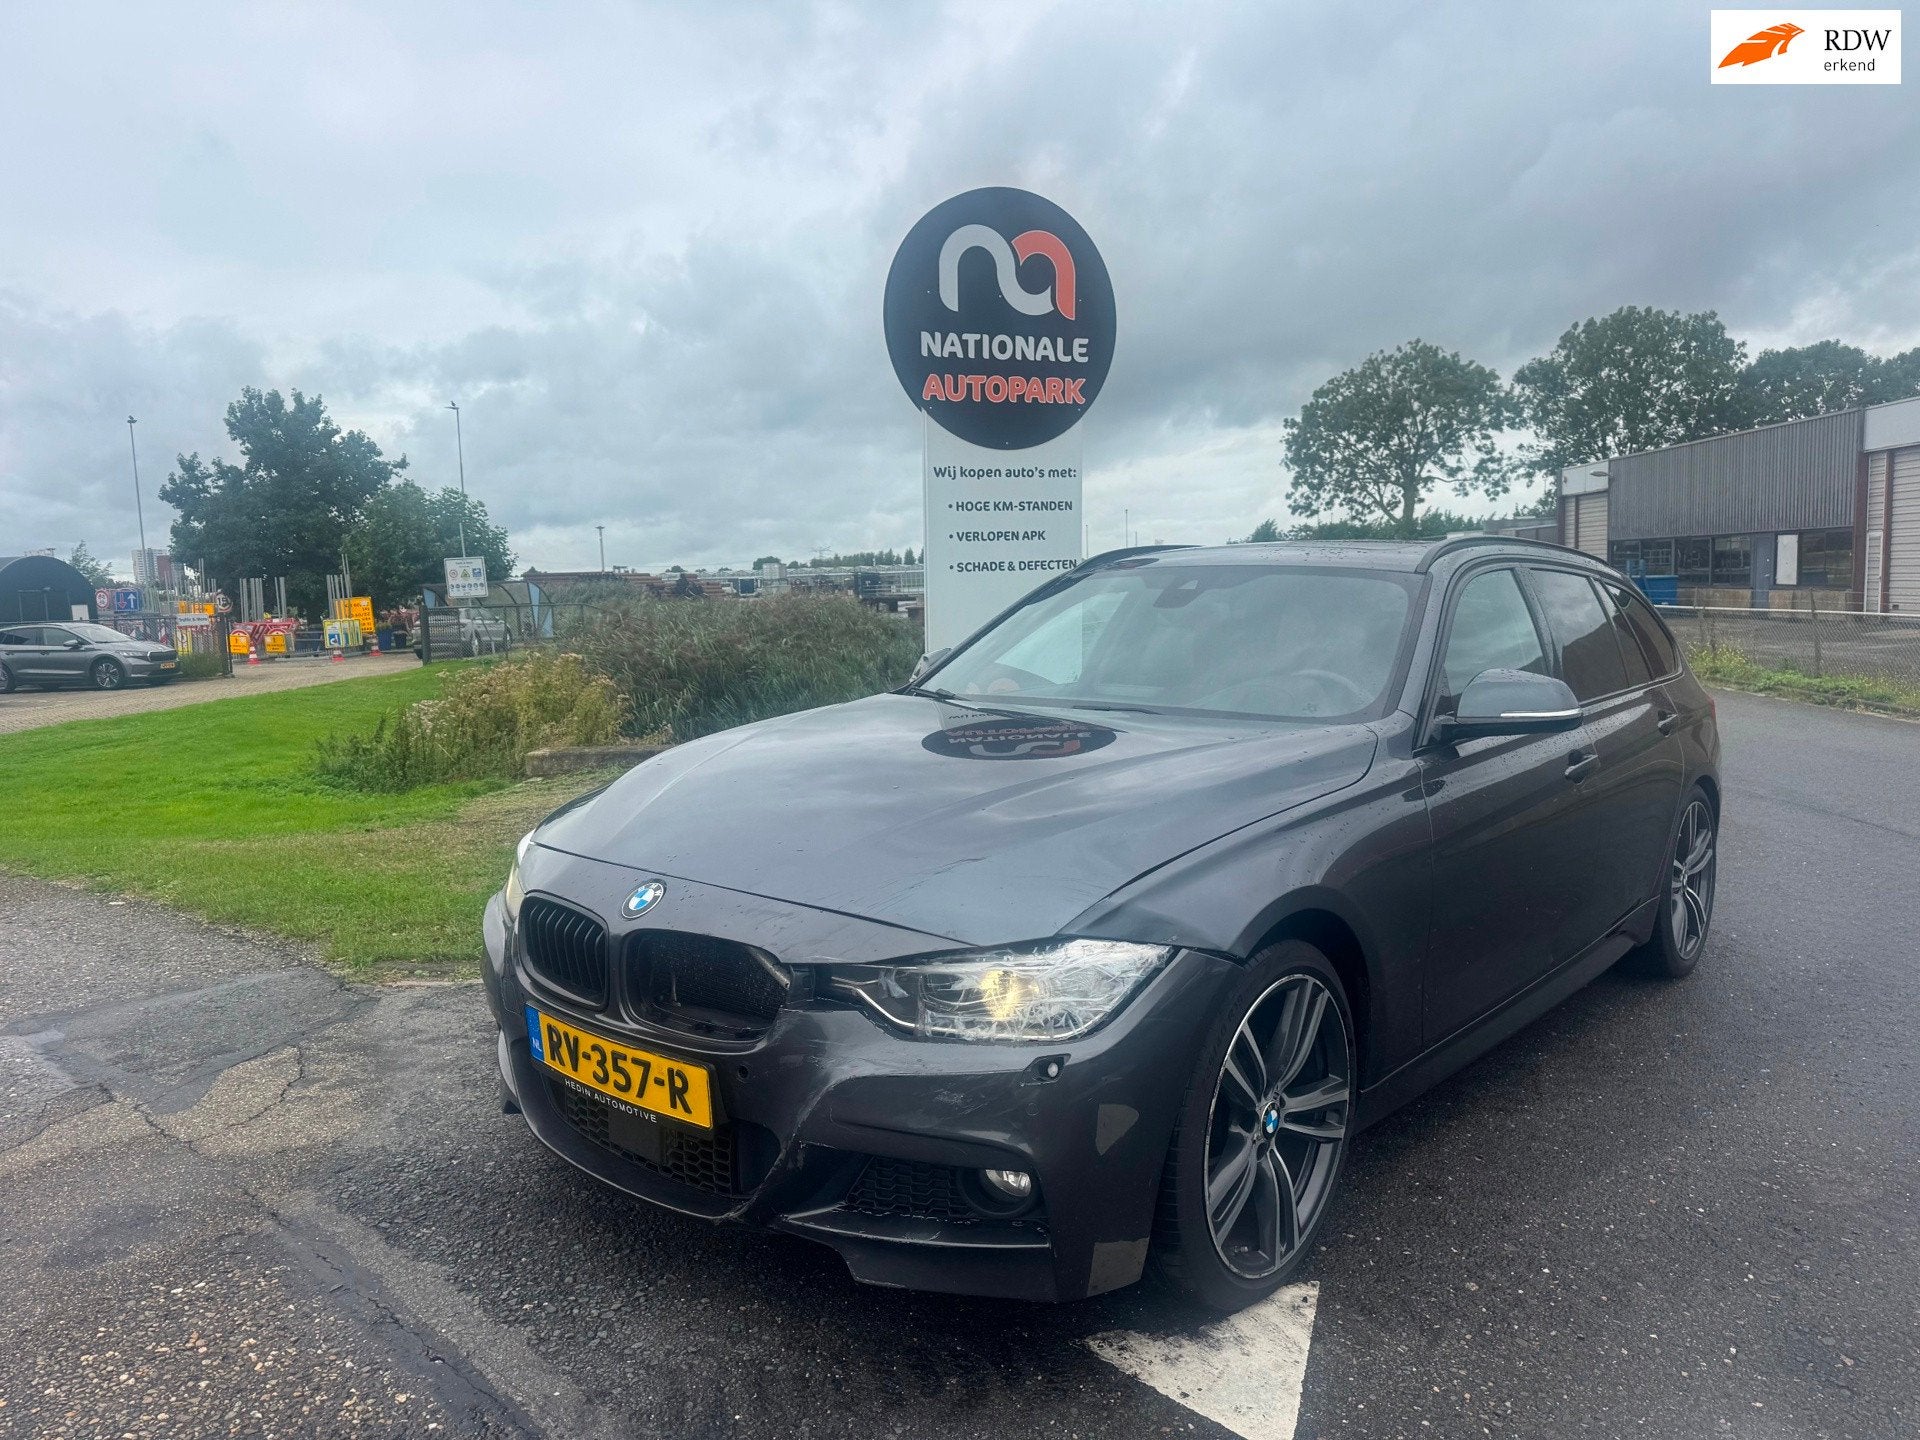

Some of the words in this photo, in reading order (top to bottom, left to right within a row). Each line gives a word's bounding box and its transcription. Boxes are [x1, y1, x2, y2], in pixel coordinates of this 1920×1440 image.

[920, 331, 1089, 363] NATIONALE
[922, 373, 1086, 405] AUTOPARK
[933, 465, 957, 481] Wij
[959, 466, 1001, 480] kopen
[1005, 466, 1045, 479] auto's
[1048, 467, 1077, 479] met:
[955, 501, 991, 512] HOGE
[993, 500, 1073, 512] KM-STANDEN
[956, 531, 1020, 542] VERLOPEN
[1021, 530, 1046, 541] APK
[956, 561, 1006, 573] SCHADE
[1007, 561, 1016, 572] &
[1018, 559, 1078, 571] DEFECTEN
[531, 1037, 542, 1053] NL
[546, 1023, 693, 1115] RV-357-R
[564, 1078, 591, 1097] HEDIN
[594, 1093, 658, 1123] AUTOMOTIVE
